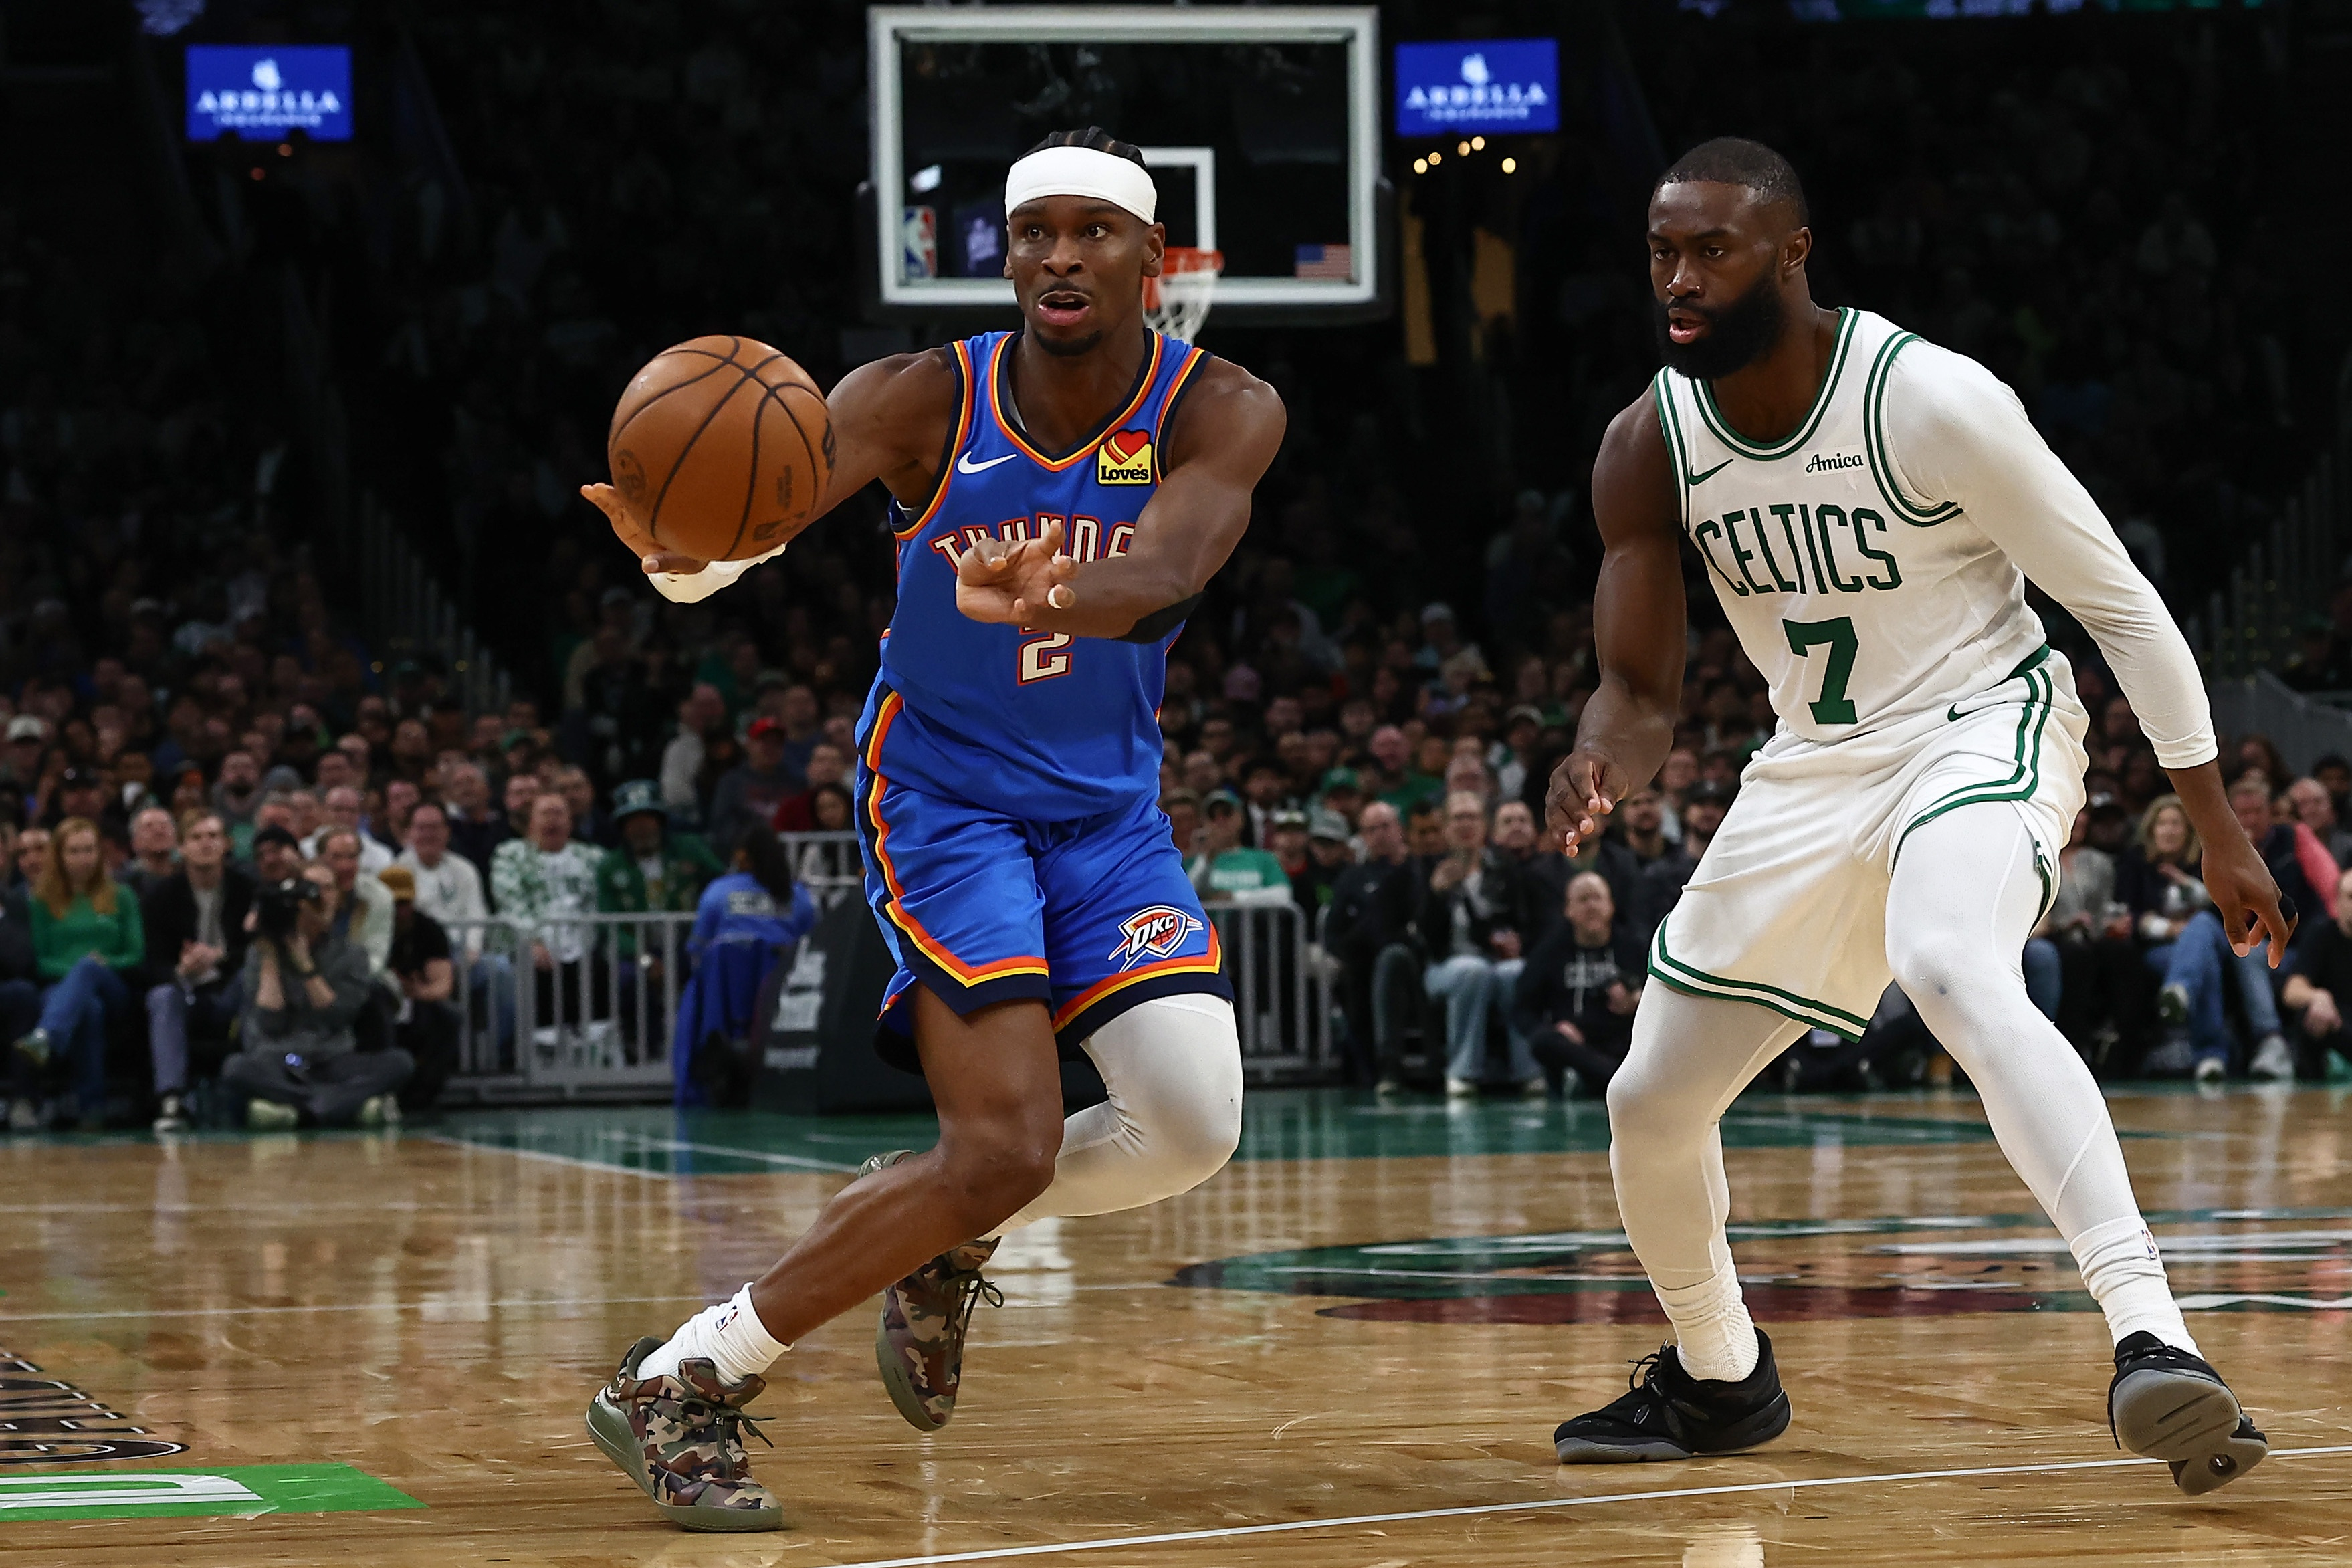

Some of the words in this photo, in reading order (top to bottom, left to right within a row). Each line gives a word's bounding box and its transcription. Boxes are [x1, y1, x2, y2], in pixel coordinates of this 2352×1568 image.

[1806, 453, 1864, 473] Amica
[1695, 503, 1903, 597] CELTICS
[1017, 625, 1075, 686] 2
[1782, 616, 1859, 725] 7
[1130, 915, 1174, 954] OKC
